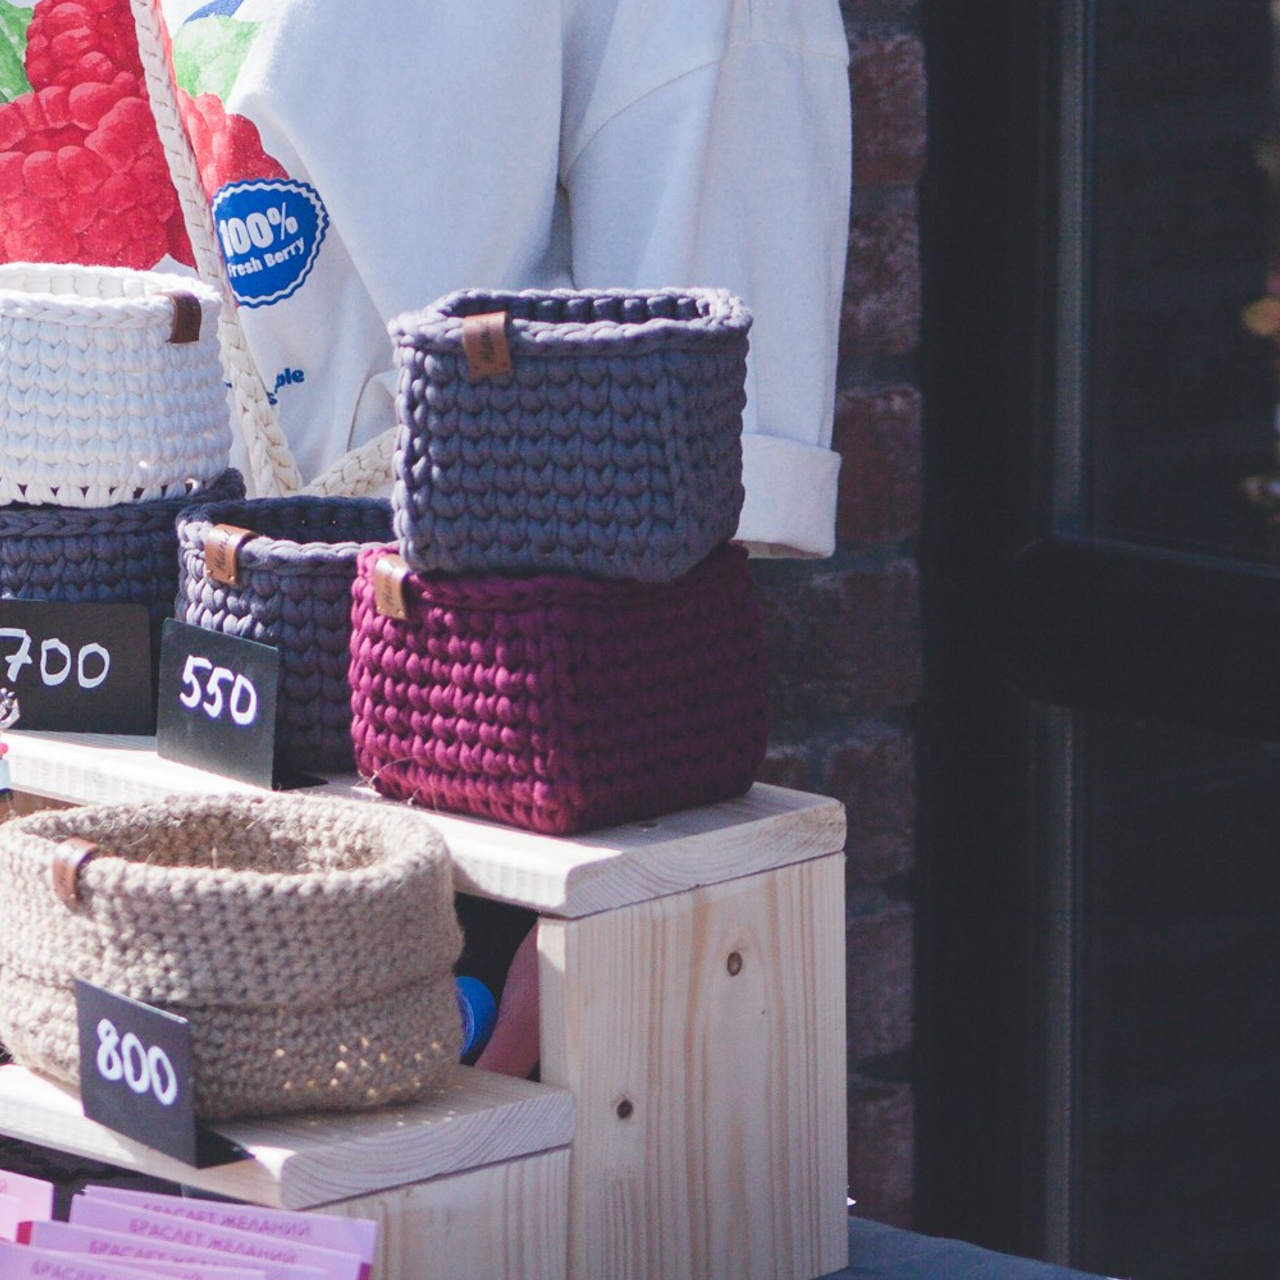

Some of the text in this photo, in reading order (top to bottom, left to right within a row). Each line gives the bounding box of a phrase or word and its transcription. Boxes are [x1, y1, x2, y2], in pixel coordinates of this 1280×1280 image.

[220, 202, 298, 257] 100%
[263, 236, 304, 268] Berry
[180, 655, 257, 725] 550
[97, 1018, 177, 1105] 800
[129, 1219, 205, 1247] БРАСЛЕТ
